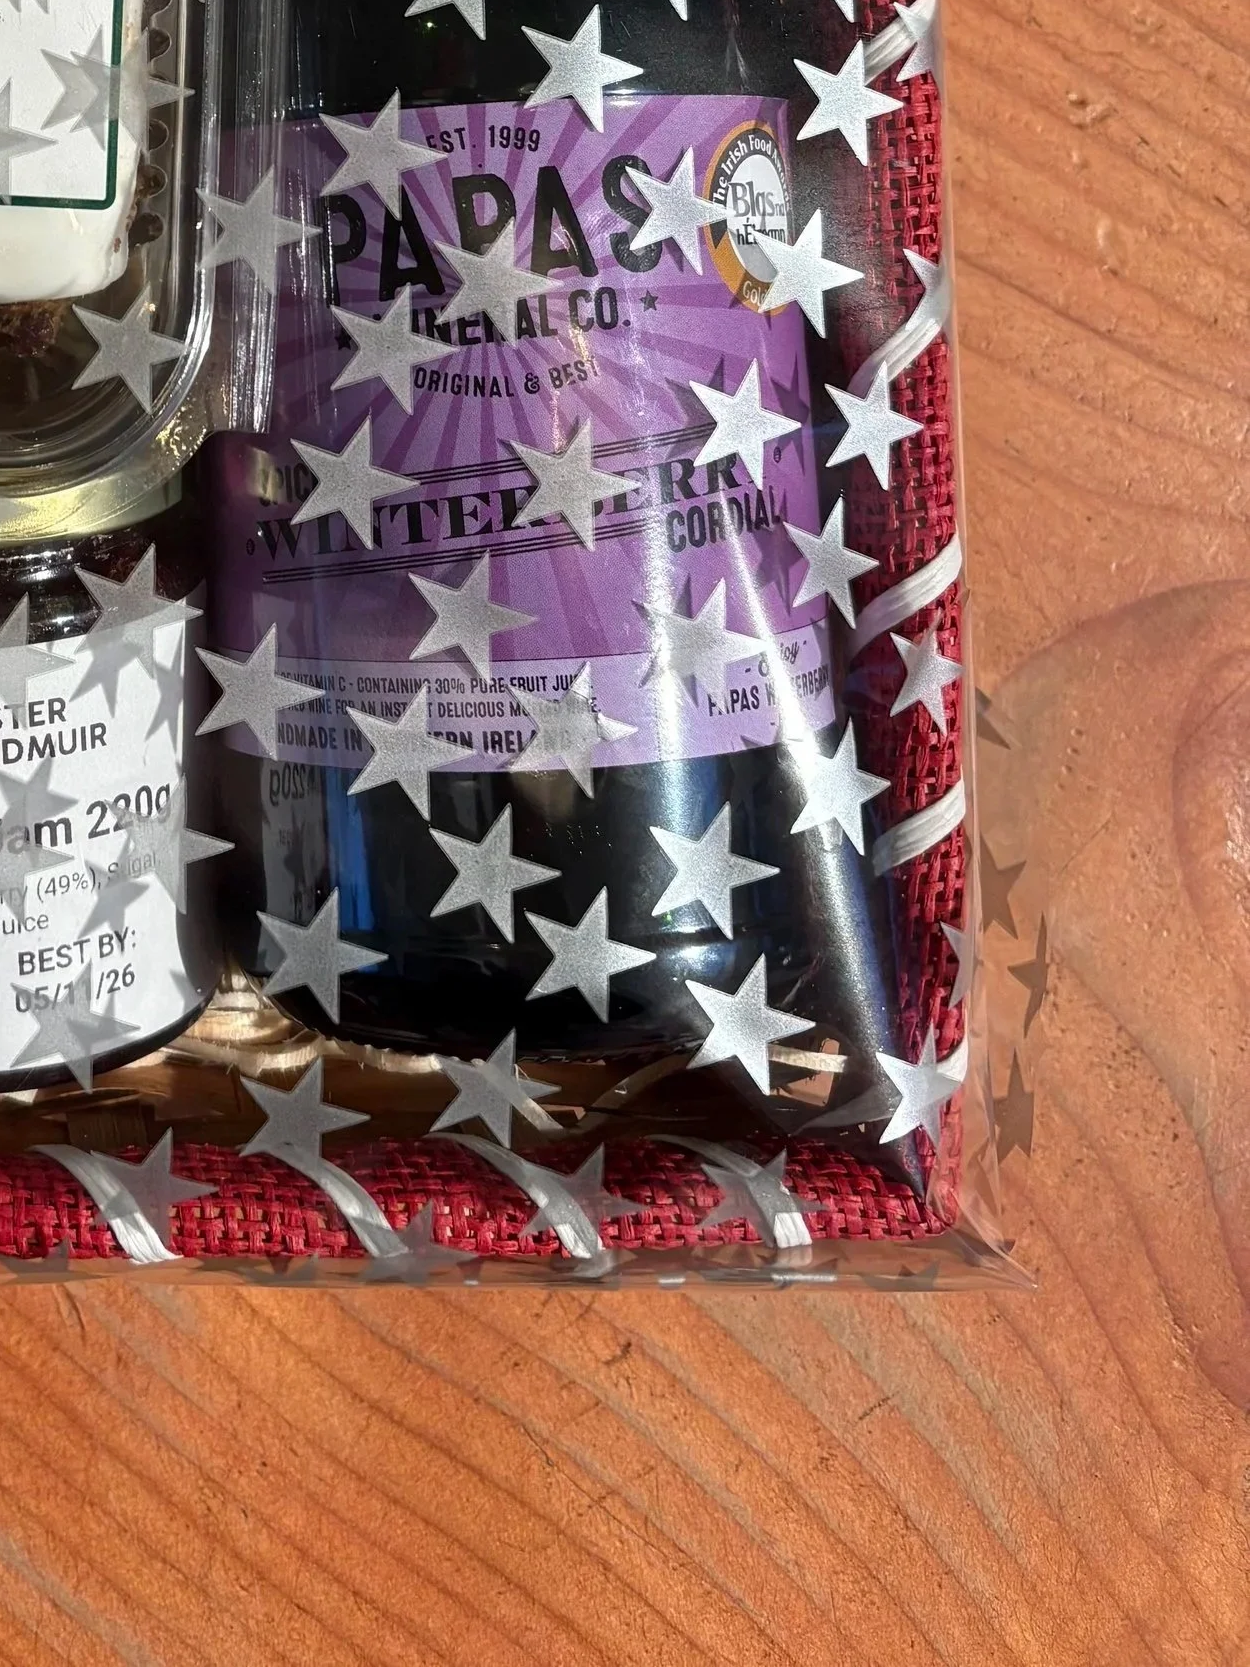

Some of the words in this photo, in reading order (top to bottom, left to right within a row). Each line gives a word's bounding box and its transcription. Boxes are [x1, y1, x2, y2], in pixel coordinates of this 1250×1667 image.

[488, 125, 542, 152] 1999
[721, 140, 749, 176] Irish
[748, 134, 772, 156] Food
[326, 154, 663, 308] PAPAS
[405, 292, 558, 346] INEAL
[567, 286, 632, 333] CO.
[414, 365, 514, 399] ORIGINAL
[524, 372, 541, 394] &
[548, 355, 601, 390] BEST
[665, 485, 783, 554] CORDIAL
[338, 676, 347, 692] C
[357, 676, 432, 694] CONTAINING
[435, 678, 465, 694] 30%
[470, 677, 506, 694] PURE
[509, 674, 548, 692] FRUIT
[361, 701, 376, 717] AN
[380, 701, 433, 718] INSTT
[437, 701, 505, 718] DELICIOUS
[277, 722, 337, 751] NDMADE
[343, 728, 363, 751] IN
[85, 782, 173, 841] 220g
[35, 870, 102, 905] (49%),
[17, 938, 91, 977] BEST
[97, 926, 138, 959] BY:
